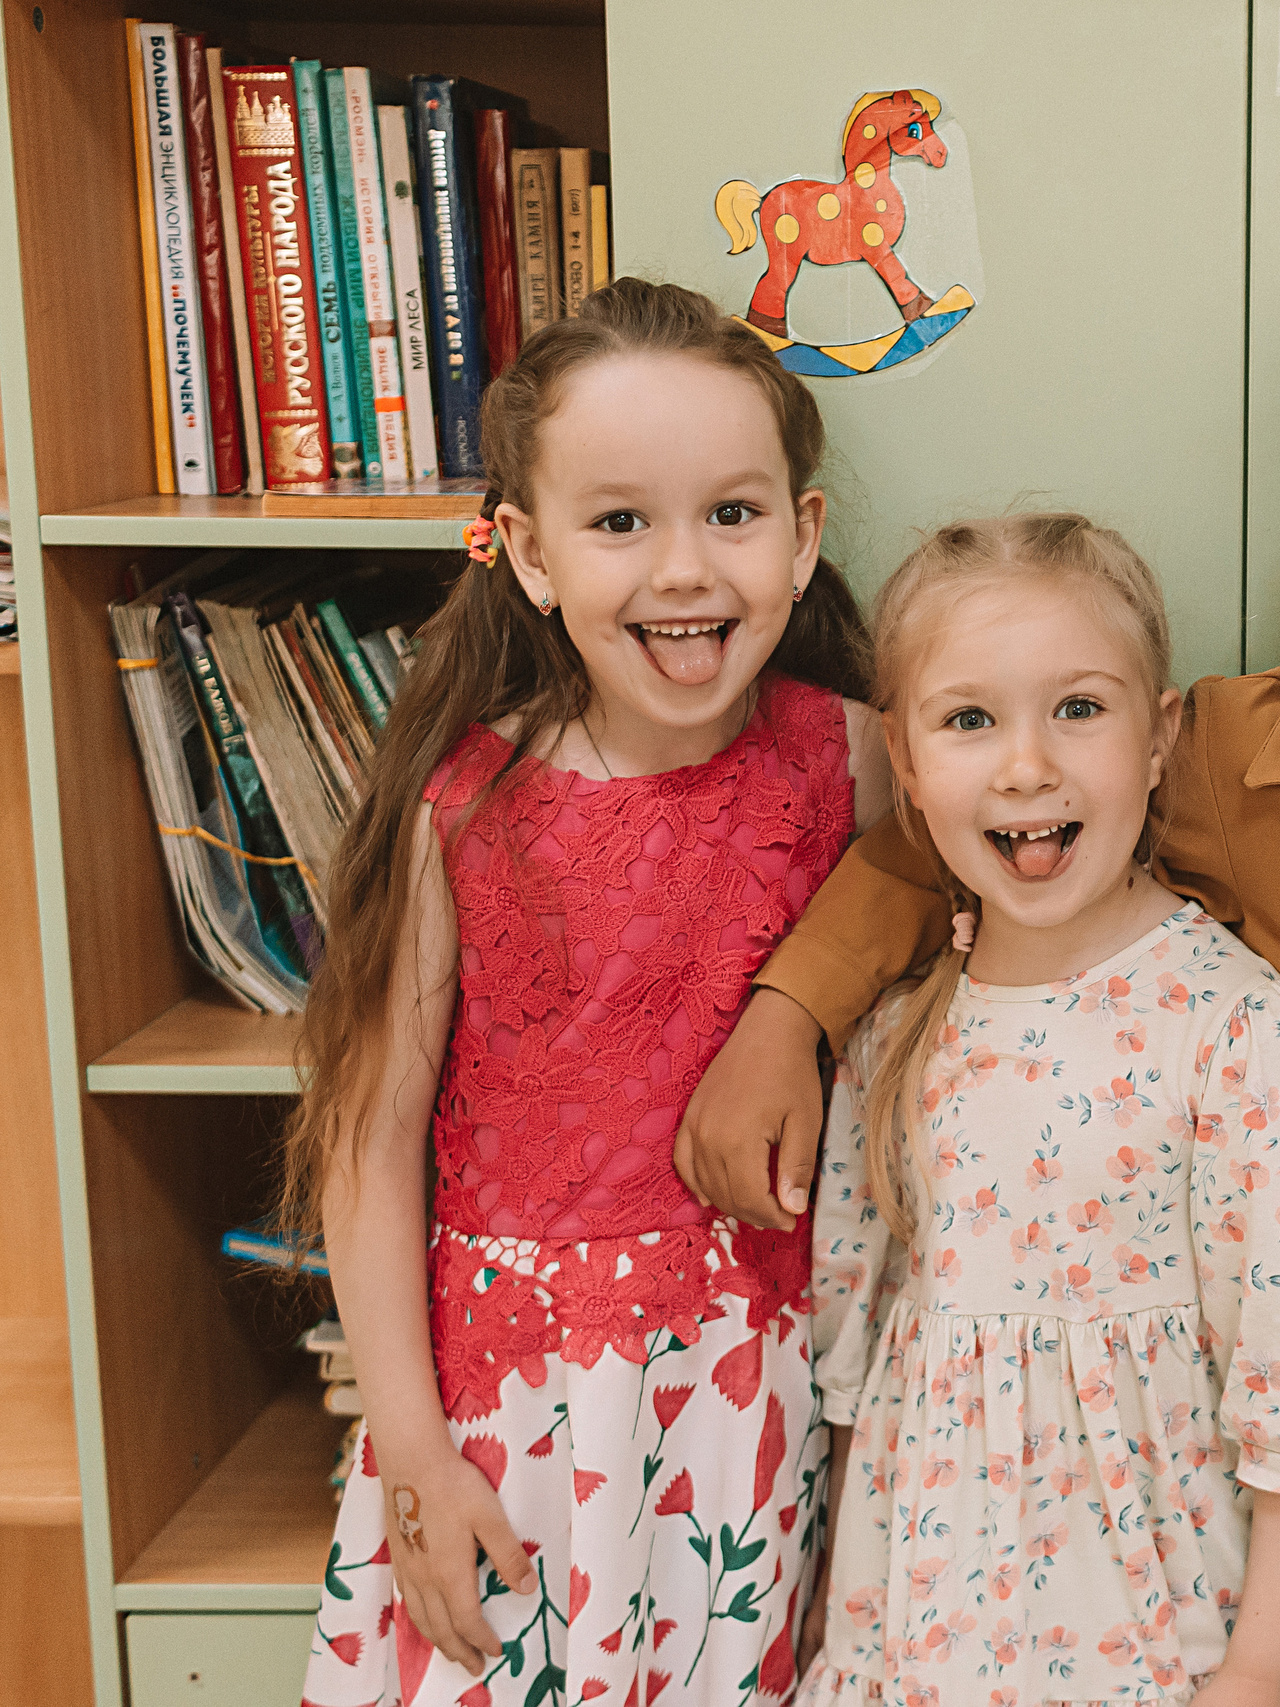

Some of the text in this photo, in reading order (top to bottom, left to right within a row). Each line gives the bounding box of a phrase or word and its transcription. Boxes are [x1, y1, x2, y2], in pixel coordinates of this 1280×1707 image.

[151, 35, 173, 137] БОЛЬШАЯ
[302, 108, 324, 174] королей
[159, 141, 184, 279] ЭНЦИКЛОПЕДИЯ
[312, 183, 334, 273] подземных
[526, 199, 544, 260] КАМНЯ
[265, 160, 313, 406] РУССКОГО НАРОДА
[322, 280, 341, 343] СЕМЬ
[358, 177, 375, 245] ИСТОРИЯ
[367, 253, 382, 321] ОТКРЫТИ
[376, 345, 397, 460] ЭНЦИКПЕДИЯ
[406, 288, 425, 370] МИР ЛЕСА
